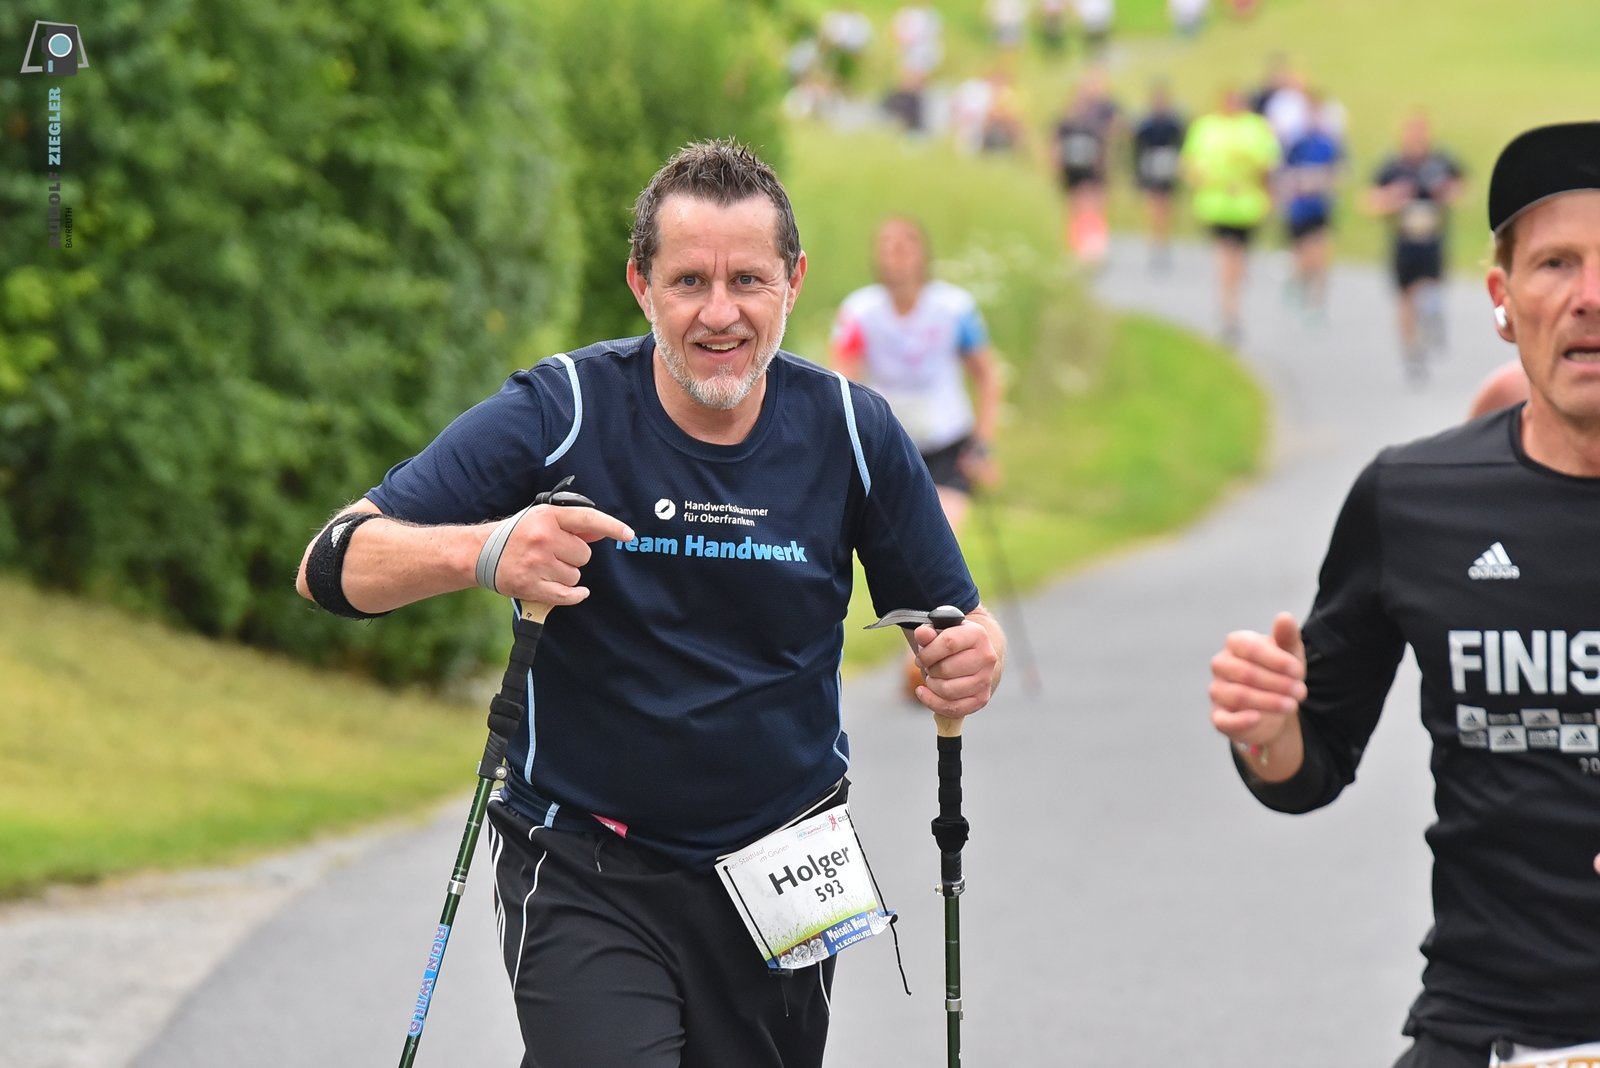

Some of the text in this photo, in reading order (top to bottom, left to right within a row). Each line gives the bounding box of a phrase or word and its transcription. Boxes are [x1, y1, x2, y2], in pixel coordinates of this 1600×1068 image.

[684, 501, 768, 516] Handwerkskammer
[683, 512, 756, 527] für Oberfranken
[685, 535, 807, 561] Handwerk
[1467, 564, 1521, 580] adidas
[1448, 630, 1600, 695] FINIS
[738, 847, 766, 865] Stadtlauf
[769, 847, 850, 895] Holger
[814, 879, 845, 903] 593
[826, 922, 853, 943] Maisel's
